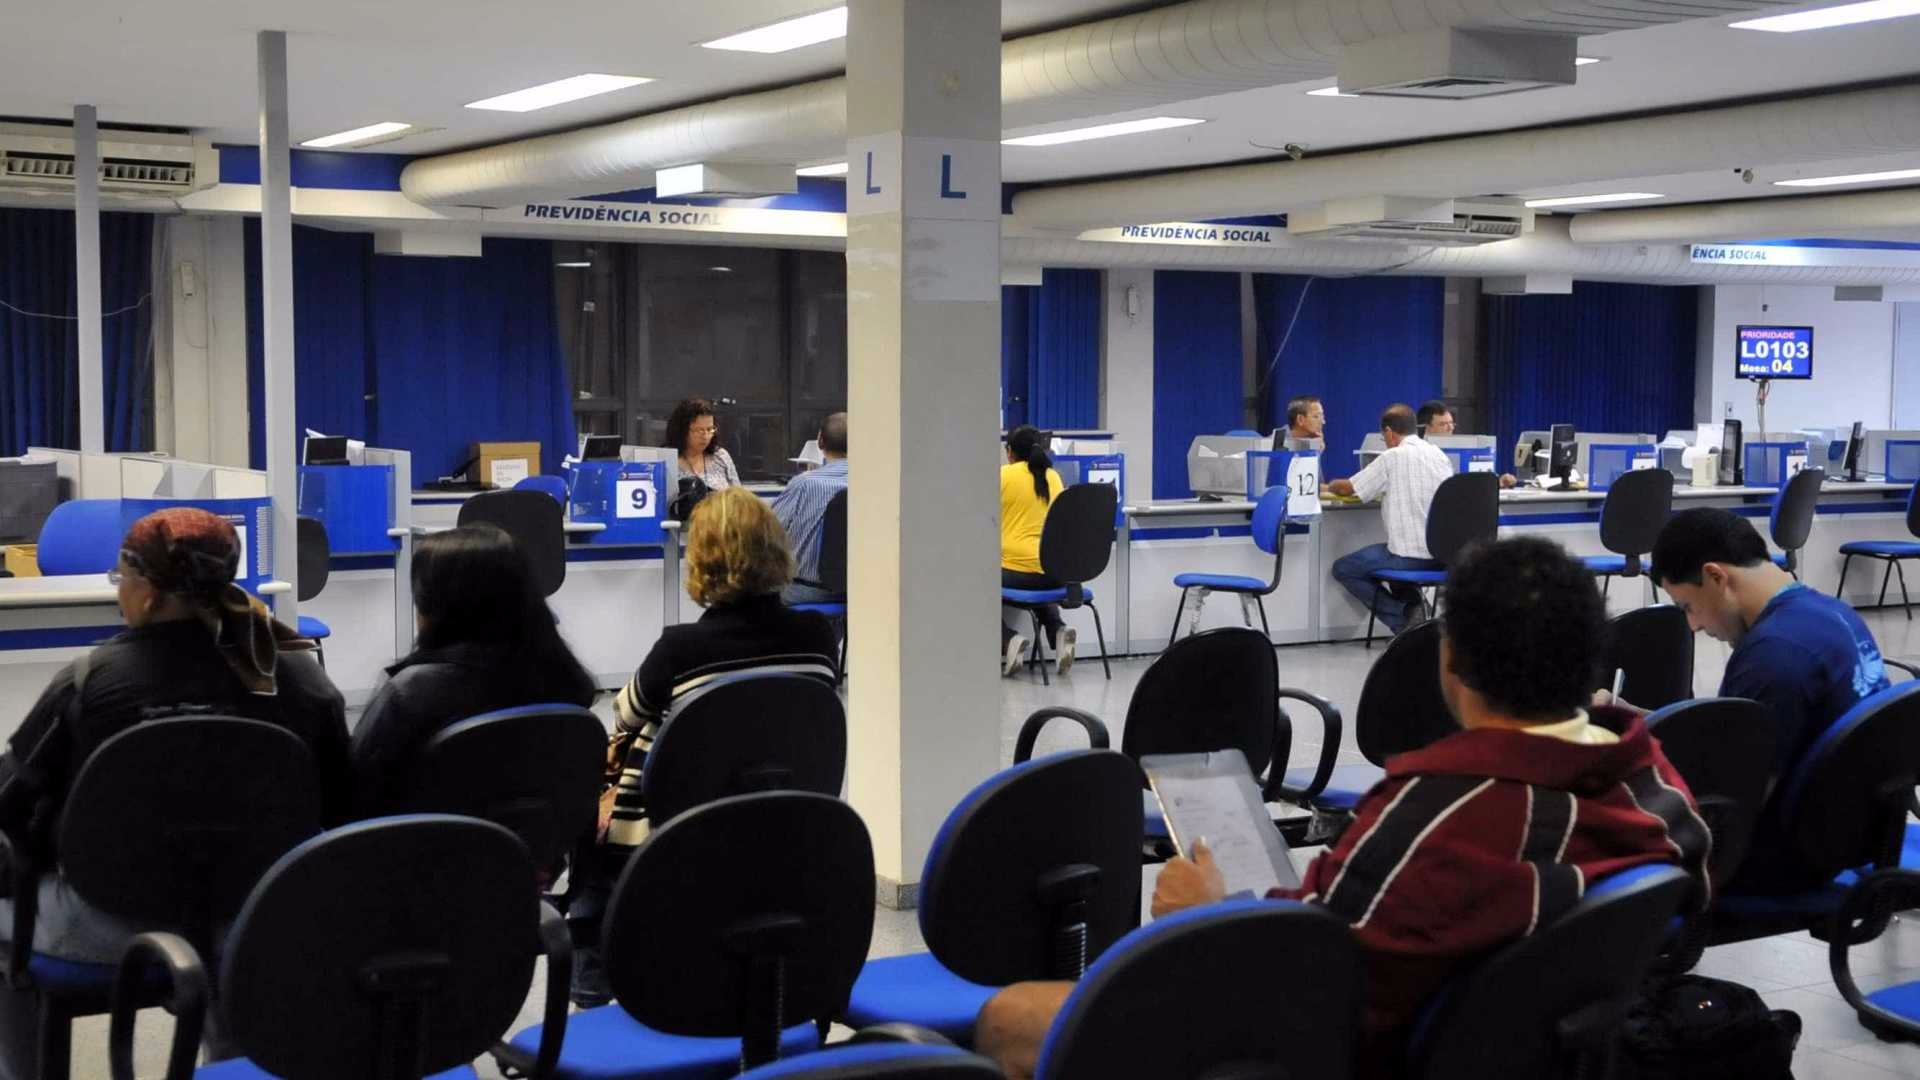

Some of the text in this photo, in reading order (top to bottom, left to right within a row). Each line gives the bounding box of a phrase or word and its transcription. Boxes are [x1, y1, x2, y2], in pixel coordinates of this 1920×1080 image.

[866, 152, 881, 194] L
[941, 155, 966, 199] L
[524, 204, 721, 225] PREVIDÊNCIA SOCIAL
[1121, 226, 1271, 242] PREVIDÊNCIA SOCIAL
[1729, 249, 1767, 260] SOCIAL
[1741, 330, 1795, 339] PRIORIDADE
[1742, 341, 1809, 358] L0103
[1771, 359, 1793, 373] 04
[1297, 473, 1315, 497] 12
[631, 488, 648, 510] 9
